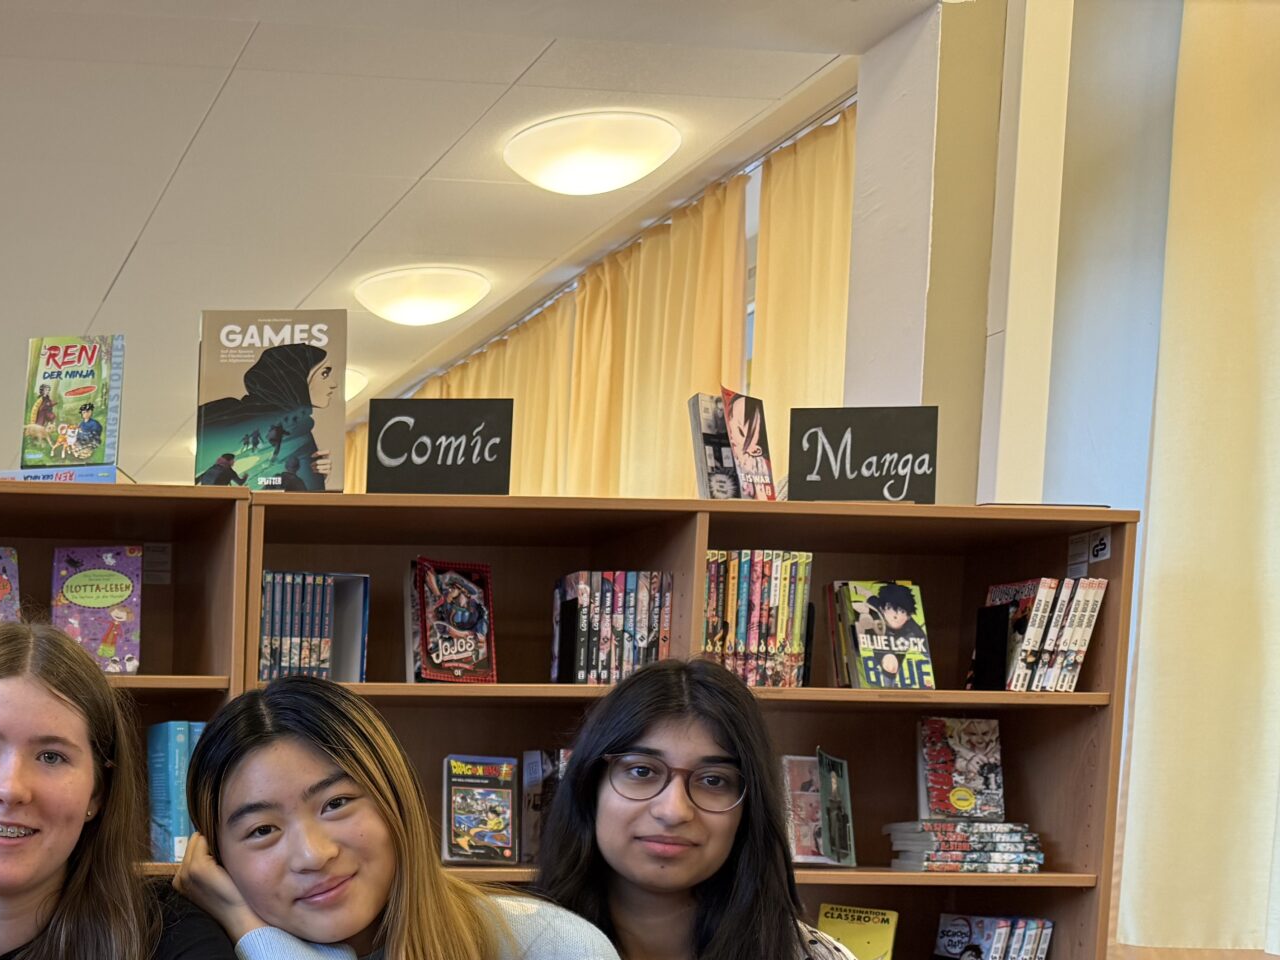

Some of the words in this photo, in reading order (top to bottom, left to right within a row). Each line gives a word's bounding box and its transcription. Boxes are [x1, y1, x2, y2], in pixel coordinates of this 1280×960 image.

[220, 324, 329, 348] GAMES
[45, 344, 99, 369] REN
[43, 371, 62, 380] DER
[64, 369, 95, 379] NINJA
[377, 416, 501, 467] Comic
[802, 426, 933, 501] Manga
[859, 634, 890, 651] BLUE
[890, 635, 927, 652] LOCK
[824, 911, 891, 925] CLASSROOM
[829, 906, 887, 917] ASSASSINATION
